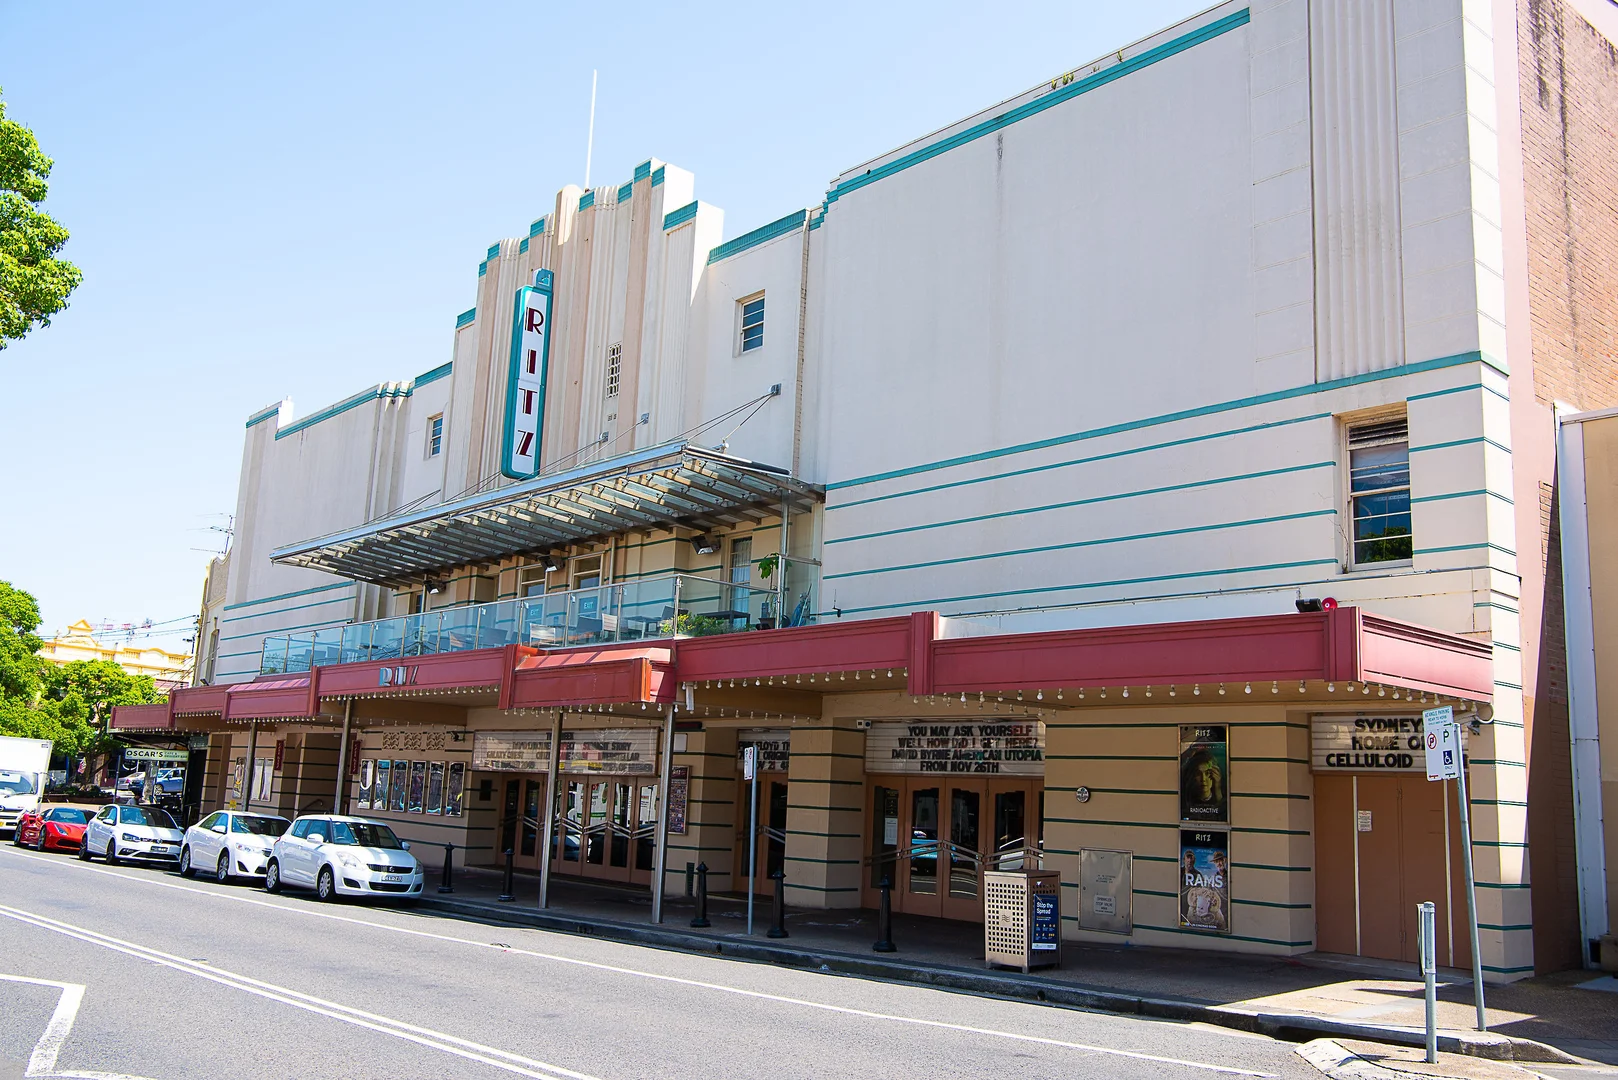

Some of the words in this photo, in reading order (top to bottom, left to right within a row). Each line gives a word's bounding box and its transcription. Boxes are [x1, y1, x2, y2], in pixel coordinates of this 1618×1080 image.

[516, 306, 544, 458] RITZ
[584, 601, 594, 609] EXIT
[530, 608, 539, 616] EXIT
[908, 726, 927, 736] YOU
[930, 726, 950, 736] MAY
[953, 726, 974, 736] ASK
[978, 725, 1032, 736] YOURSELF
[1354, 718, 1423, 733] SYDNEY
[1196, 729, 1210, 737] RITZ
[611, 742, 632, 751] STORY
[898, 738, 923, 748] WELL
[926, 738, 950, 748] HOW
[952, 738, 968, 748] DID
[972, 738, 976, 748] I
[981, 738, 1000, 748] GET
[1005, 738, 1038, 749] HERE?
[1352, 736, 1400, 750] HOME
[892, 749, 918, 760] DAVID
[921, 749, 950, 760] BYRNE
[952, 749, 1000, 760] AMERICAN
[1004, 750, 1042, 761] UTOPIA
[1326, 753, 1413, 768] CELLULOID
[920, 761, 948, 772] FROM
[950, 762, 972, 772] NOV
[1195, 834, 1211, 842] RITZ
[1185, 873, 1223, 888] RAMS
